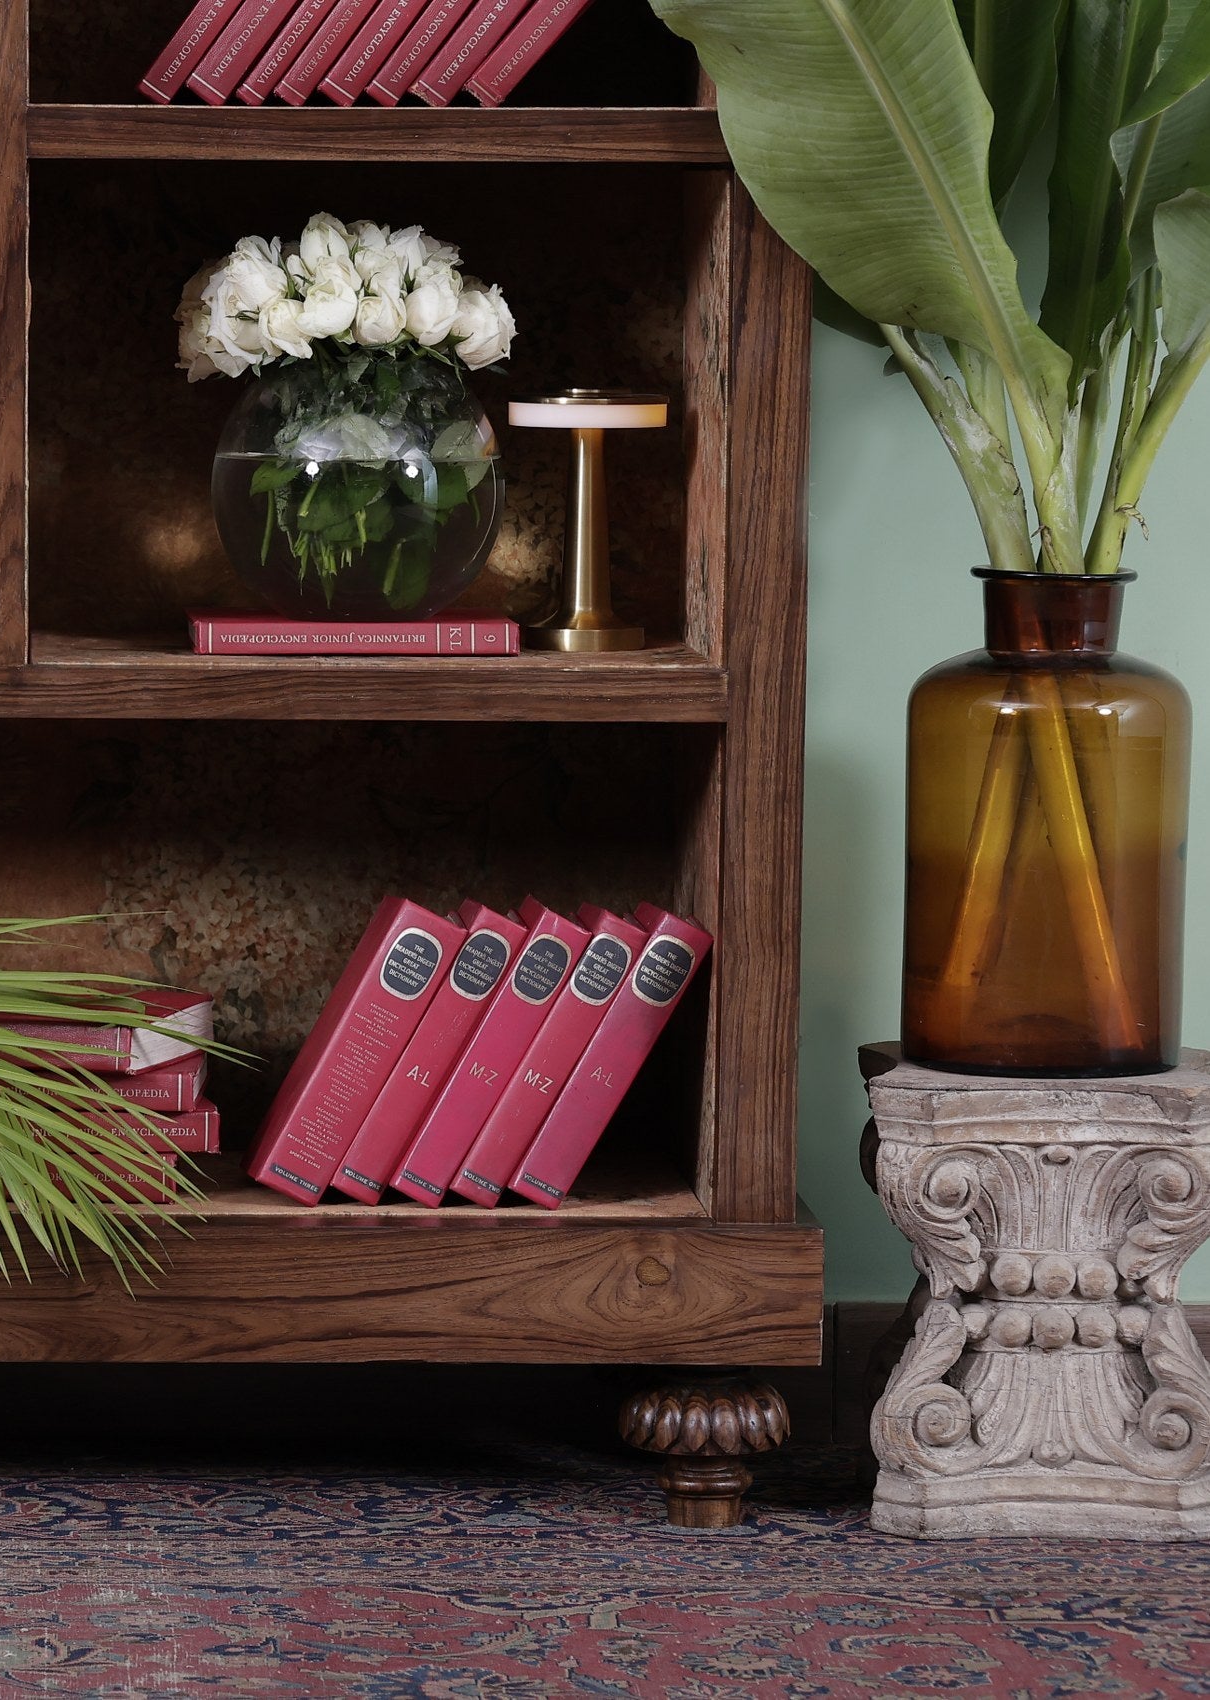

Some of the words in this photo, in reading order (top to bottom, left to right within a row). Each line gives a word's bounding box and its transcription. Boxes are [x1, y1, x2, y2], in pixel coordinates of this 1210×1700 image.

[160, 9, 217, 83] ENCYCLOPÆDIA
[211, 5, 269, 79] ENCYCLOPÆDIA
[257, 10, 314, 85] ENCYCLOPÆDIA
[297, 9, 354, 83] ENCYCLOPÆDIA
[344, 8, 401, 83] ENCYCLOPÆDIA
[390, 10, 448, 84] ENCYCLOPÆDIA
[438, 12, 497, 86] ENCYCLOPÆDIA
[490, 16, 553, 86] ENCYCLOPÆDIA
[220, 634, 307, 643] ENCYCLOPÆDIA
[312, 632, 356, 643] JUNIOR
[358, 634, 426, 643] BRITANNICA
[414, 944, 425, 954] THE
[483, 946, 493, 954] THE
[544, 950, 554, 959] THE
[604, 950, 614, 959] THE
[667, 952, 678, 960] THE
[403, 958, 420, 970] GREAT
[417, 956, 436, 968] DIGEST
[472, 958, 488, 970] GREAT
[486, 956, 503, 968] DIGEST
[534, 964, 549, 974] GREAT
[548, 962, 564, 973] DIGEST
[592, 963, 610, 974] GREAT
[606, 962, 624, 973] DIGEST
[656, 964, 672, 976] GREAT
[670, 964, 688, 976] DIGEST
[388, 968, 419, 988] DICTIONARY
[458, 970, 486, 988] DICTIONARY
[520, 974, 547, 992] DICTIONARY
[578, 974, 608, 992] DICTIONARY
[640, 974, 670, 994] DICTIONARY
[406, 1064, 430, 1088] A-L
[468, 1062, 500, 1086] M-Z
[524, 1068, 554, 1094] M-Z
[590, 1066, 614, 1088] A-L
[88, 1087, 170, 1098] LOPÆDIA
[111, 1127, 197, 1137] ENYCLPÆDIA
[274, 1166, 298, 1183] VOLUME
[300, 1179, 318, 1192] THREE
[344, 1168, 368, 1185] VOLUME
[368, 1180, 381, 1190] ONE
[404, 1171, 428, 1188] VOLUME
[428, 1184, 440, 1194] TWO
[464, 1170, 487, 1188] VOLUME
[488, 1184, 501, 1194] TWO
[524, 1174, 547, 1190] VOLUME
[548, 1186, 560, 1196] ONE
